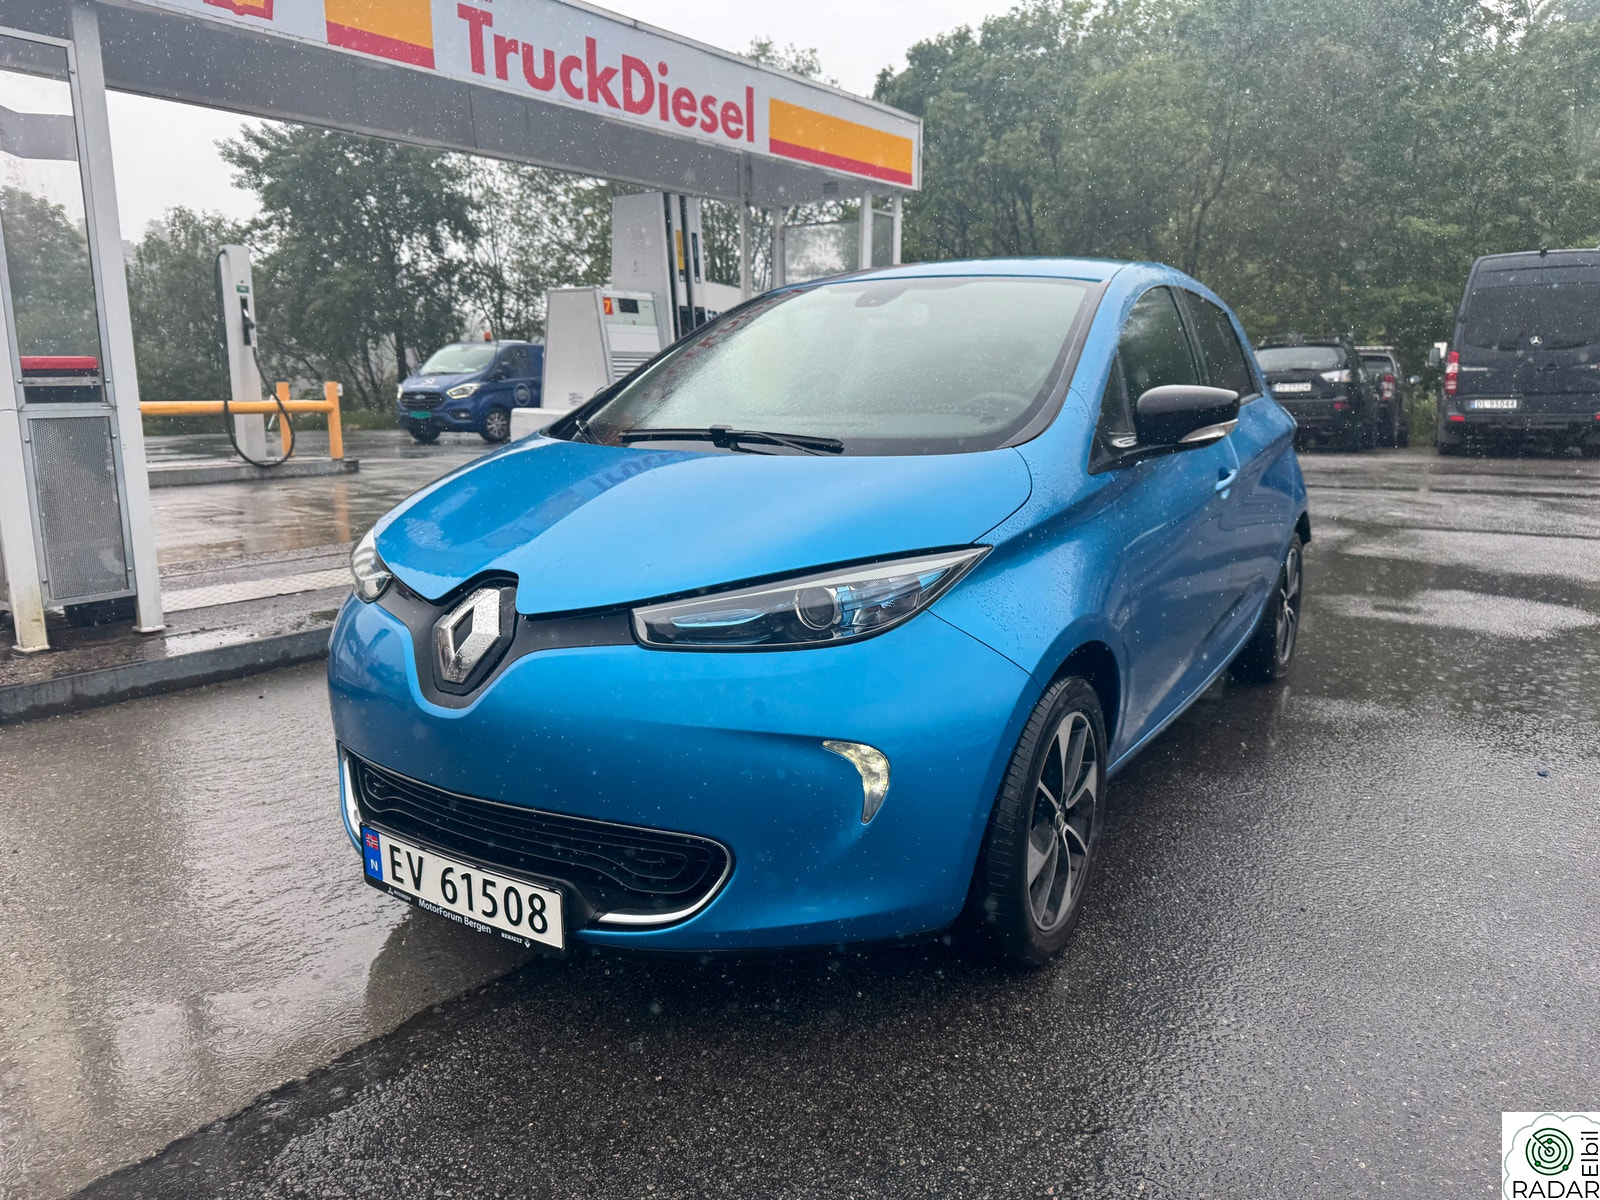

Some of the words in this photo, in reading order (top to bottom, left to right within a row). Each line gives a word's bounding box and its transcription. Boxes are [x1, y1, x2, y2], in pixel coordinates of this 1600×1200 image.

[457, 3, 755, 143] TruckDiesel
[603, 300, 611, 314] 7
[370, 858, 379, 871] N
[389, 844, 424, 891] EV
[440, 866, 549, 935] 61508
[418, 898, 463, 924] MotorForum
[463, 916, 492, 935] Bergen
[501, 932, 523, 944] RENAULT
